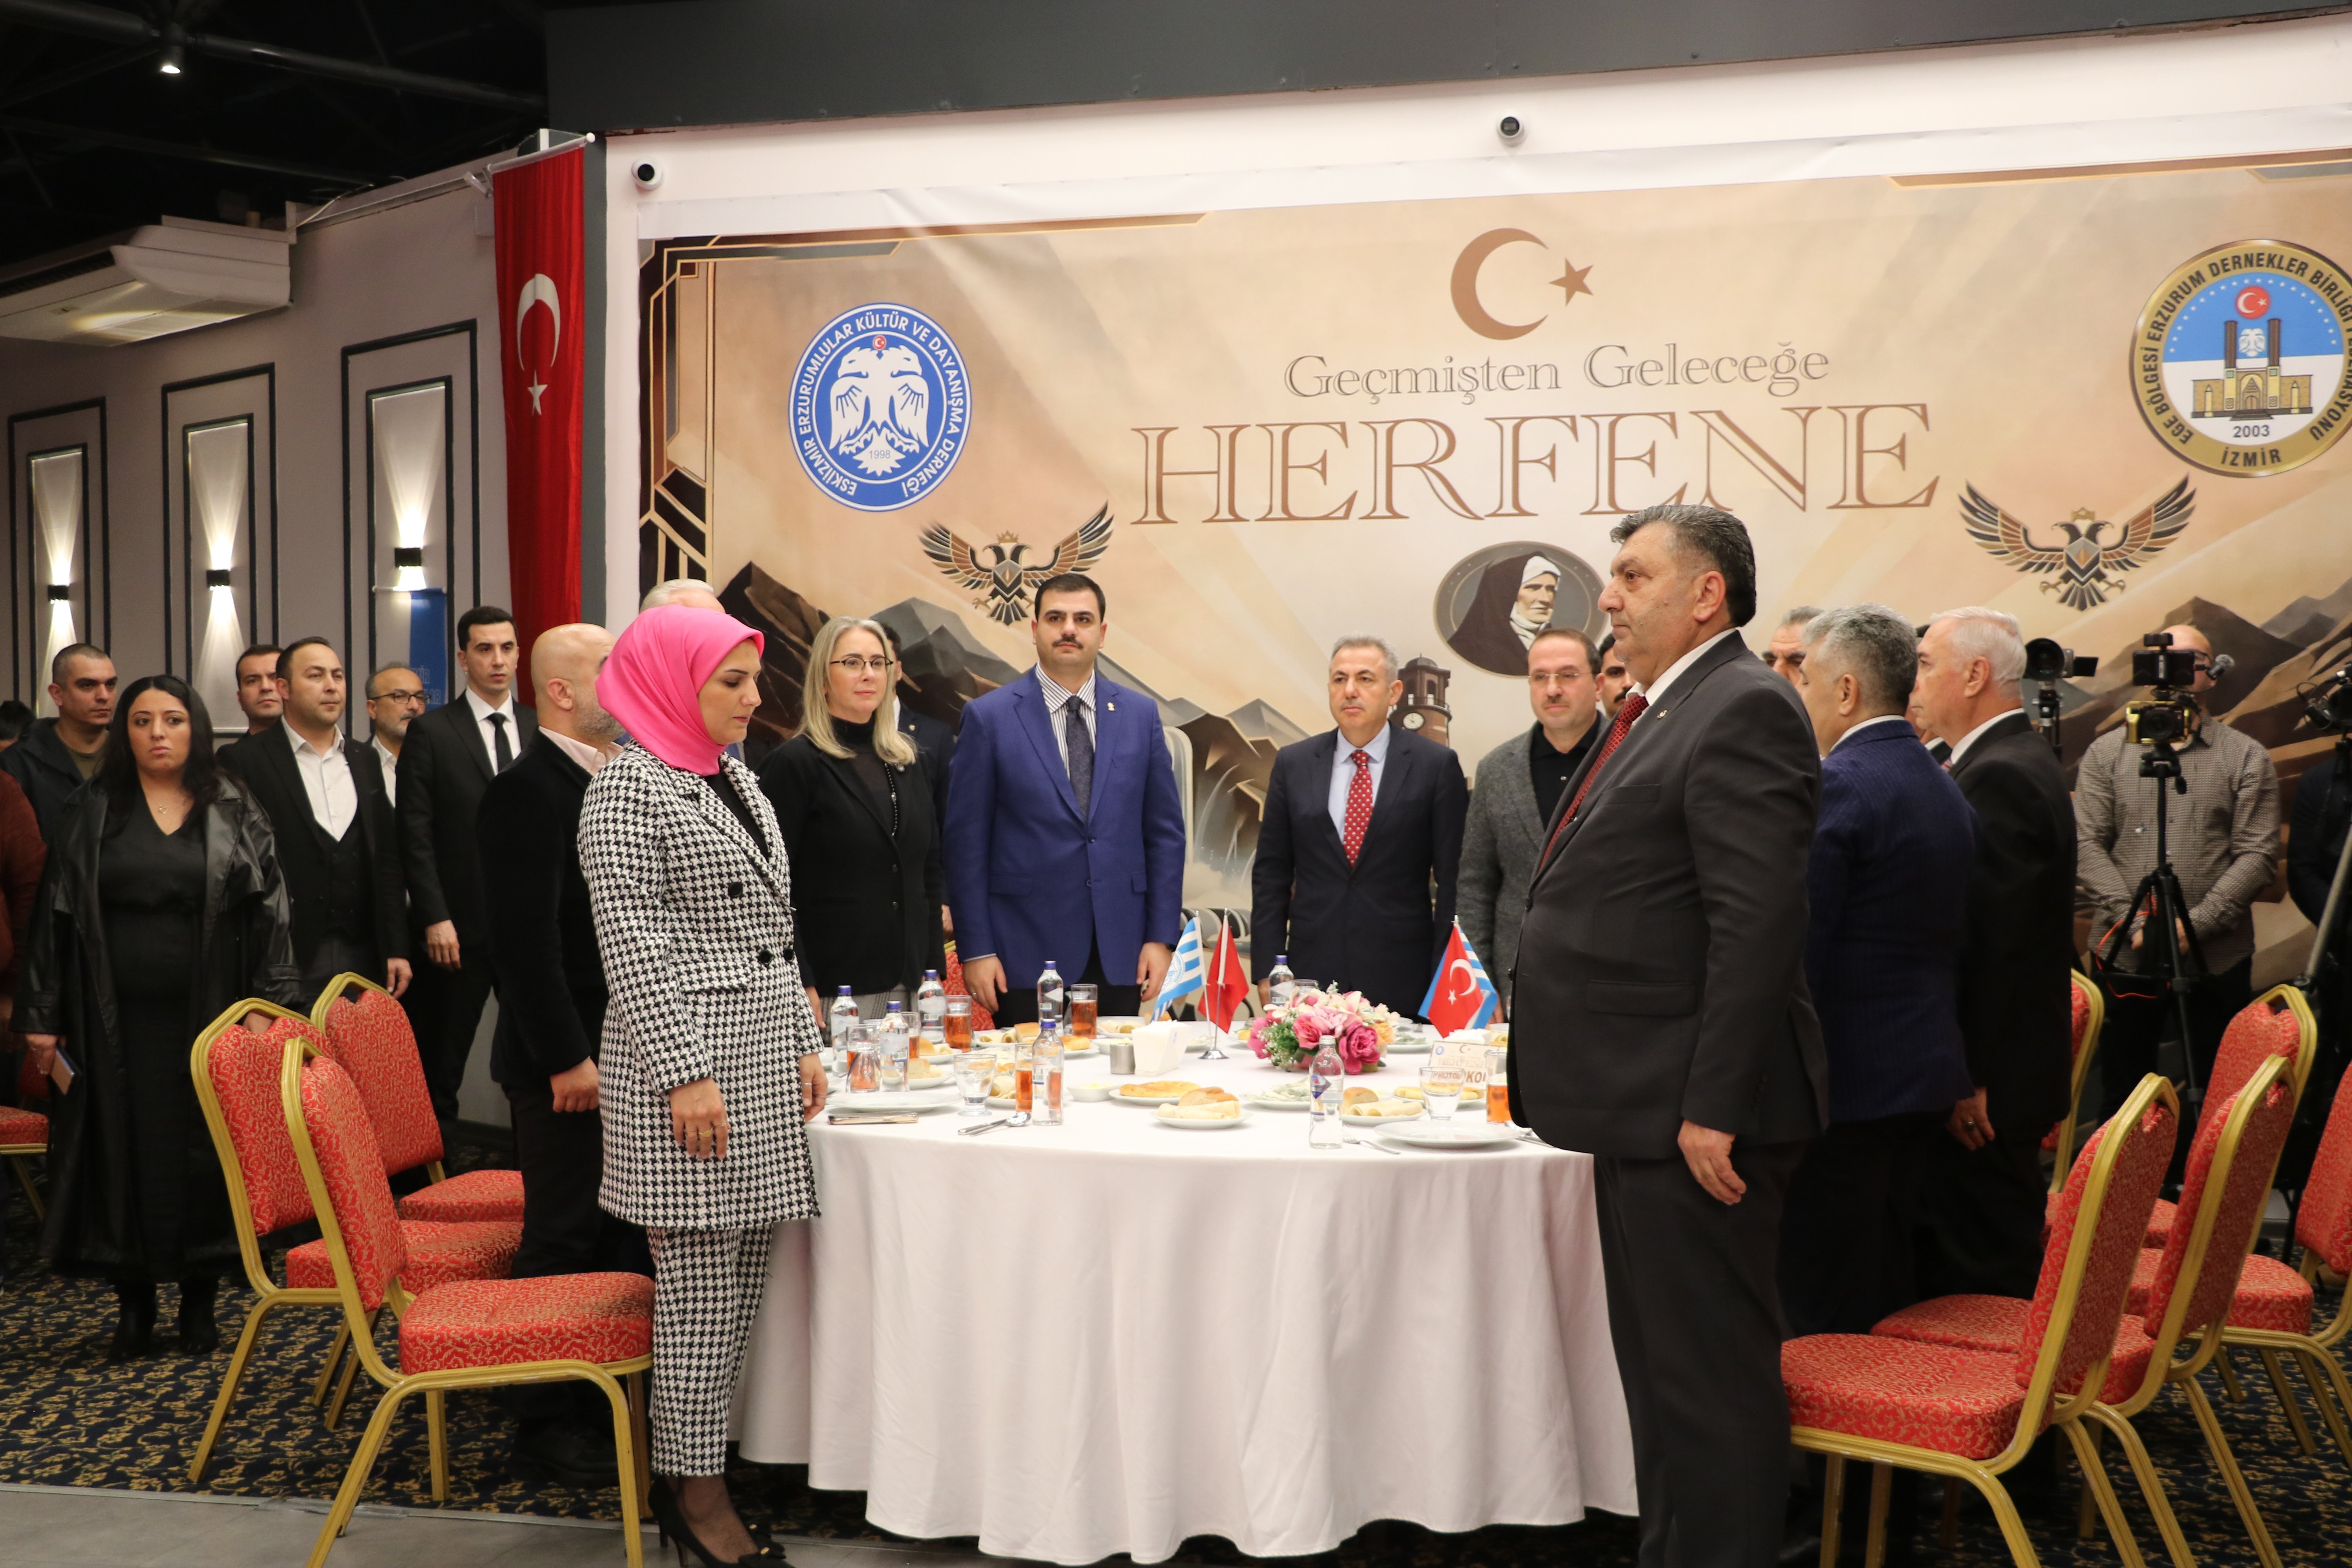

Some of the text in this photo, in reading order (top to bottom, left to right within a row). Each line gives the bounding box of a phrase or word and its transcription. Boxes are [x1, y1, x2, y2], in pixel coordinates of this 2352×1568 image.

[2208, 252, 2308, 277] DERNEKLER
[2147, 270, 2206, 341] ERZURUM
[1284, 341, 1828, 405] Geçmişten Geleceğe
[2142, 347, 2170, 416] BÖLGESİ
[797, 311, 964, 497] ESKİİZMİR ERZURUMLULAR KÜLTÜR VE DAYANIŞMA DERNEĞİ
[2163, 415, 2194, 445] EGE
[2233, 425, 2270, 438] 2003
[869, 450, 891, 459] 1998
[1131, 403, 1940, 525] HERFENE
[2221, 447, 2281, 467] İZMİR
